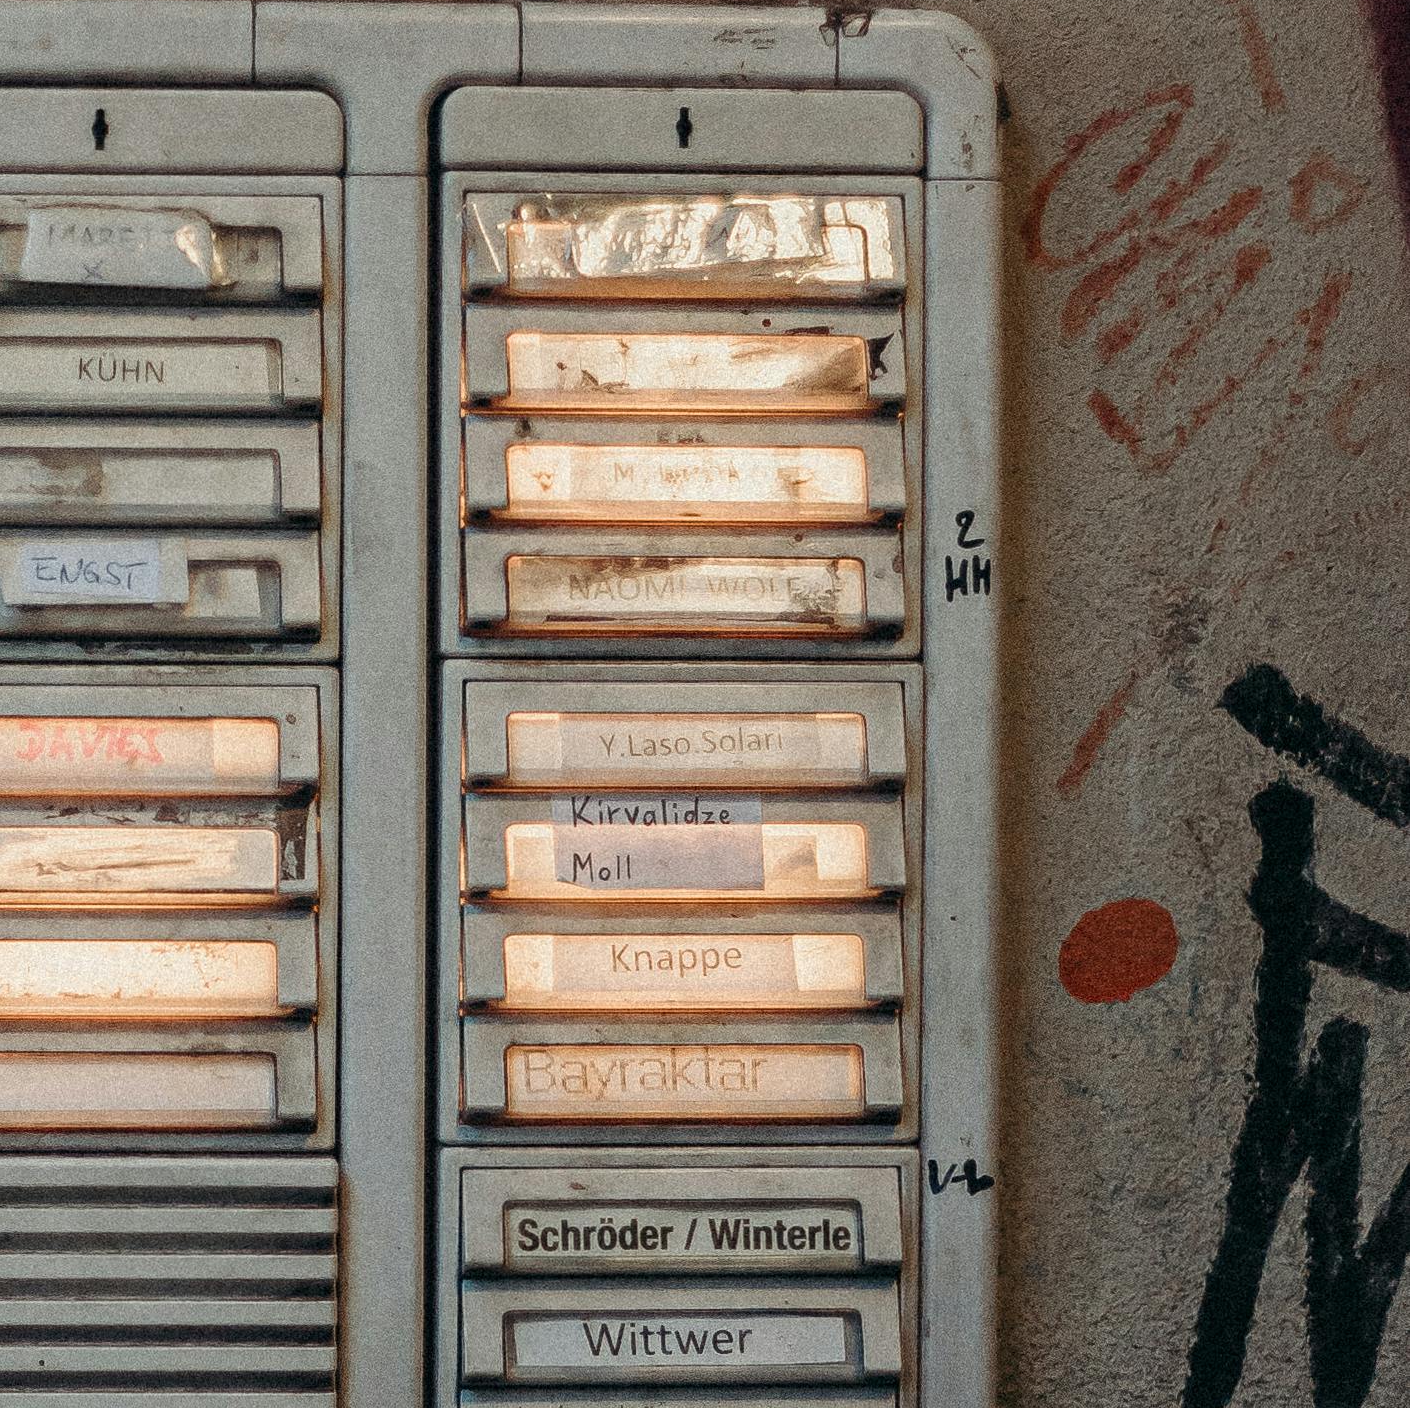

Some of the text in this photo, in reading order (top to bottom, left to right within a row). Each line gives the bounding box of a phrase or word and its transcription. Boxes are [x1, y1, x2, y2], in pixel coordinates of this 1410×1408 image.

[77, 353, 165, 384] KÜHN
[571, 796, 731, 827] Kirvalidze
[573, 853, 631, 882] Moll
[611, 944, 742, 978] Knappe
[524, 1049, 768, 1102] Bayraktar
[518, 1218, 673, 1252] Schröder
[710, 1218, 851, 1251] Winterle
[583, 1321, 753, 1356] Wittwer
